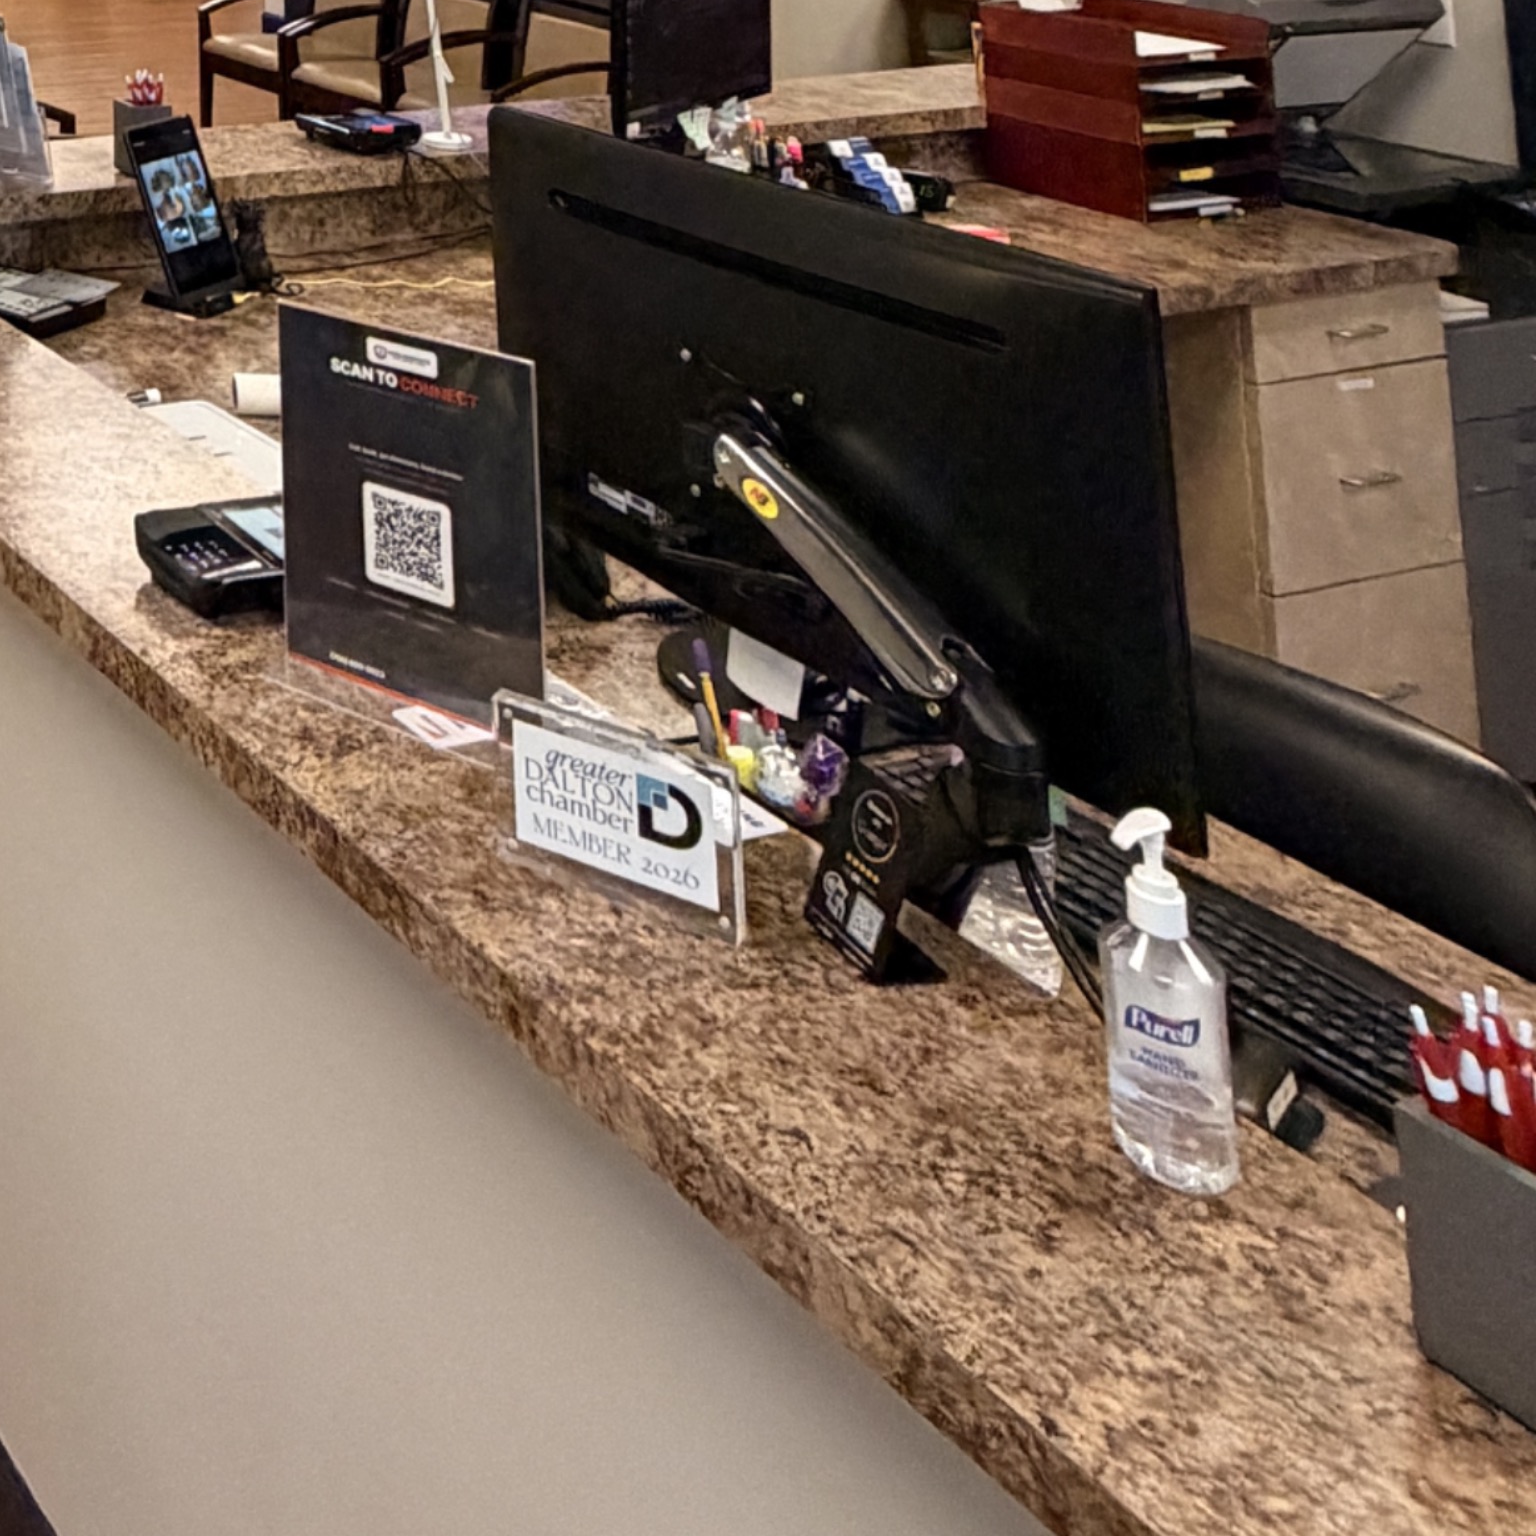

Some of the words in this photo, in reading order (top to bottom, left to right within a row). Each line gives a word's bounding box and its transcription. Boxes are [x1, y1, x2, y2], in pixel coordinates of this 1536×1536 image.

[330, 357, 374, 383] SCAN
[375, 368, 398, 388] TO
[399, 376, 479, 409] CONNECT
[525, 757, 634, 814] DALTON
[545, 749, 633, 787] greater
[526, 781, 634, 834] chamber
[532, 812, 632, 865] MEMBER
[641, 856, 700, 891] 2026
